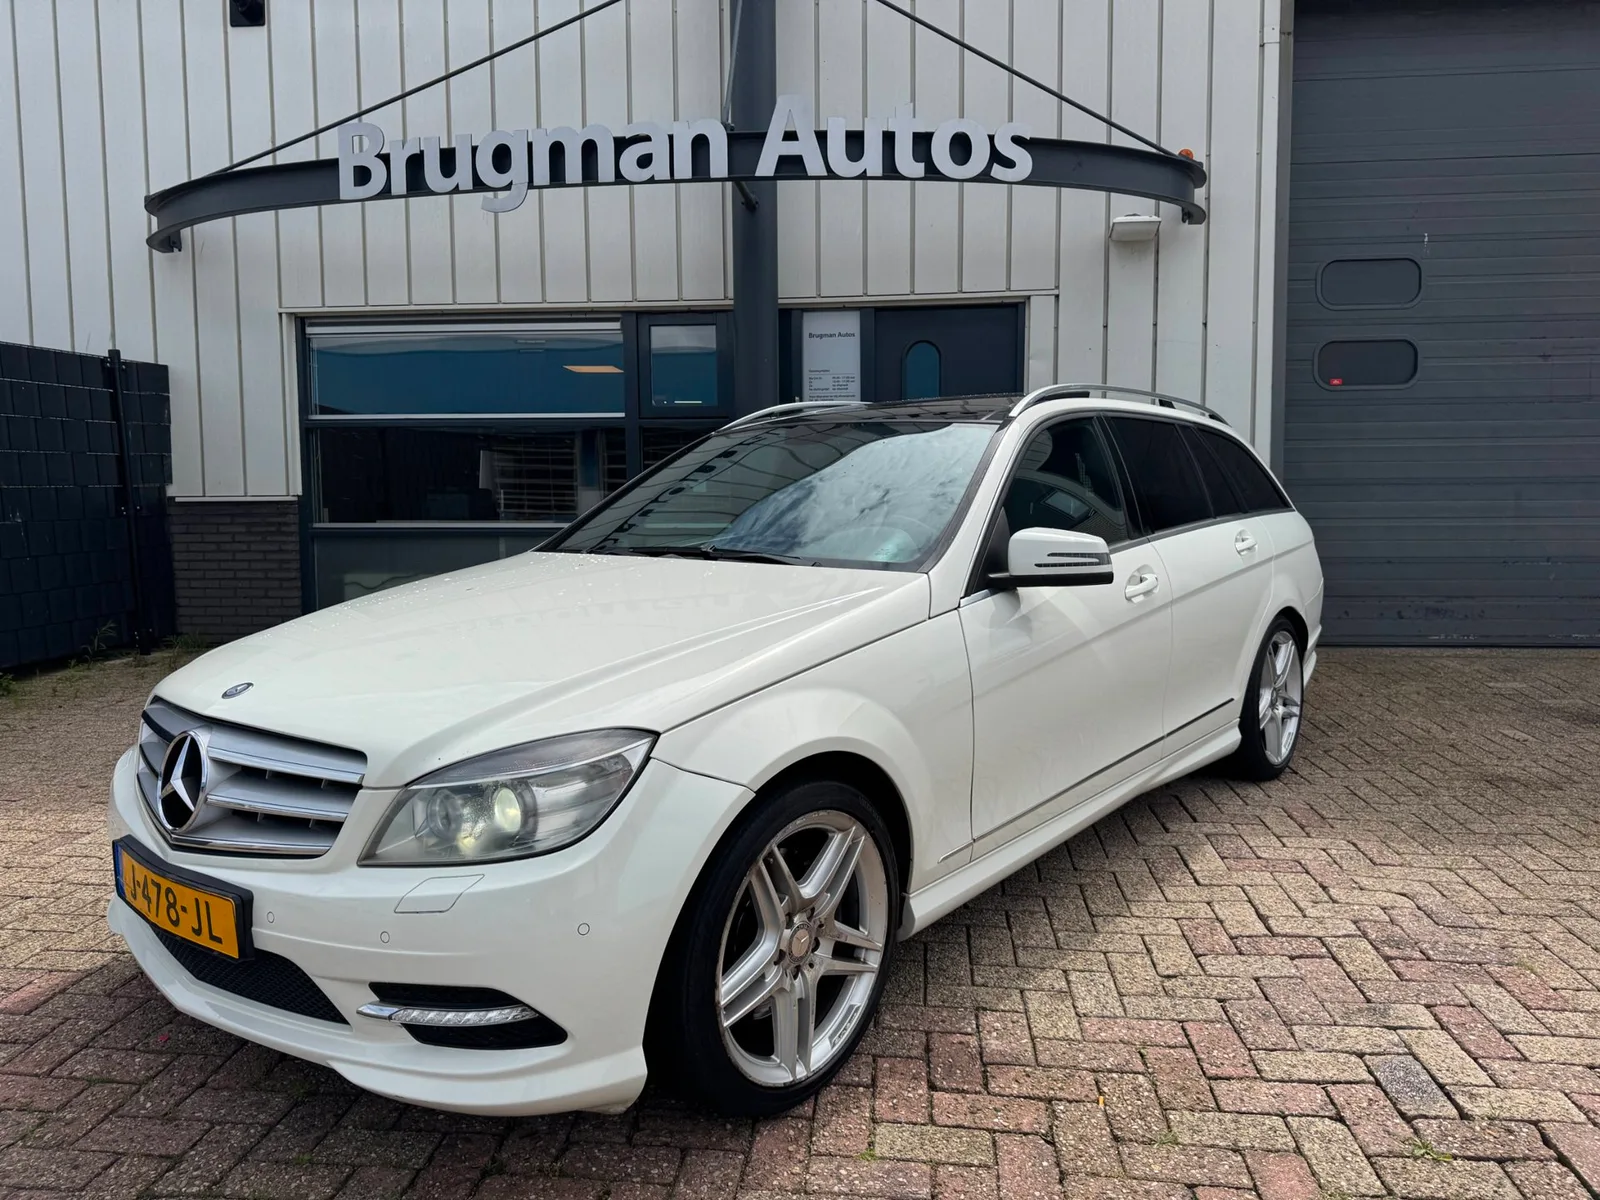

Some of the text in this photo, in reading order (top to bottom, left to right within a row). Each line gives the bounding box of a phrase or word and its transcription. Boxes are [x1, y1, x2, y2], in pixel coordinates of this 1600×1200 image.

[337, 93, 1033, 213] Brugman Autos
[808, 332, 836, 340] Brugman
[130, 863, 223, 945] J-478-JL
